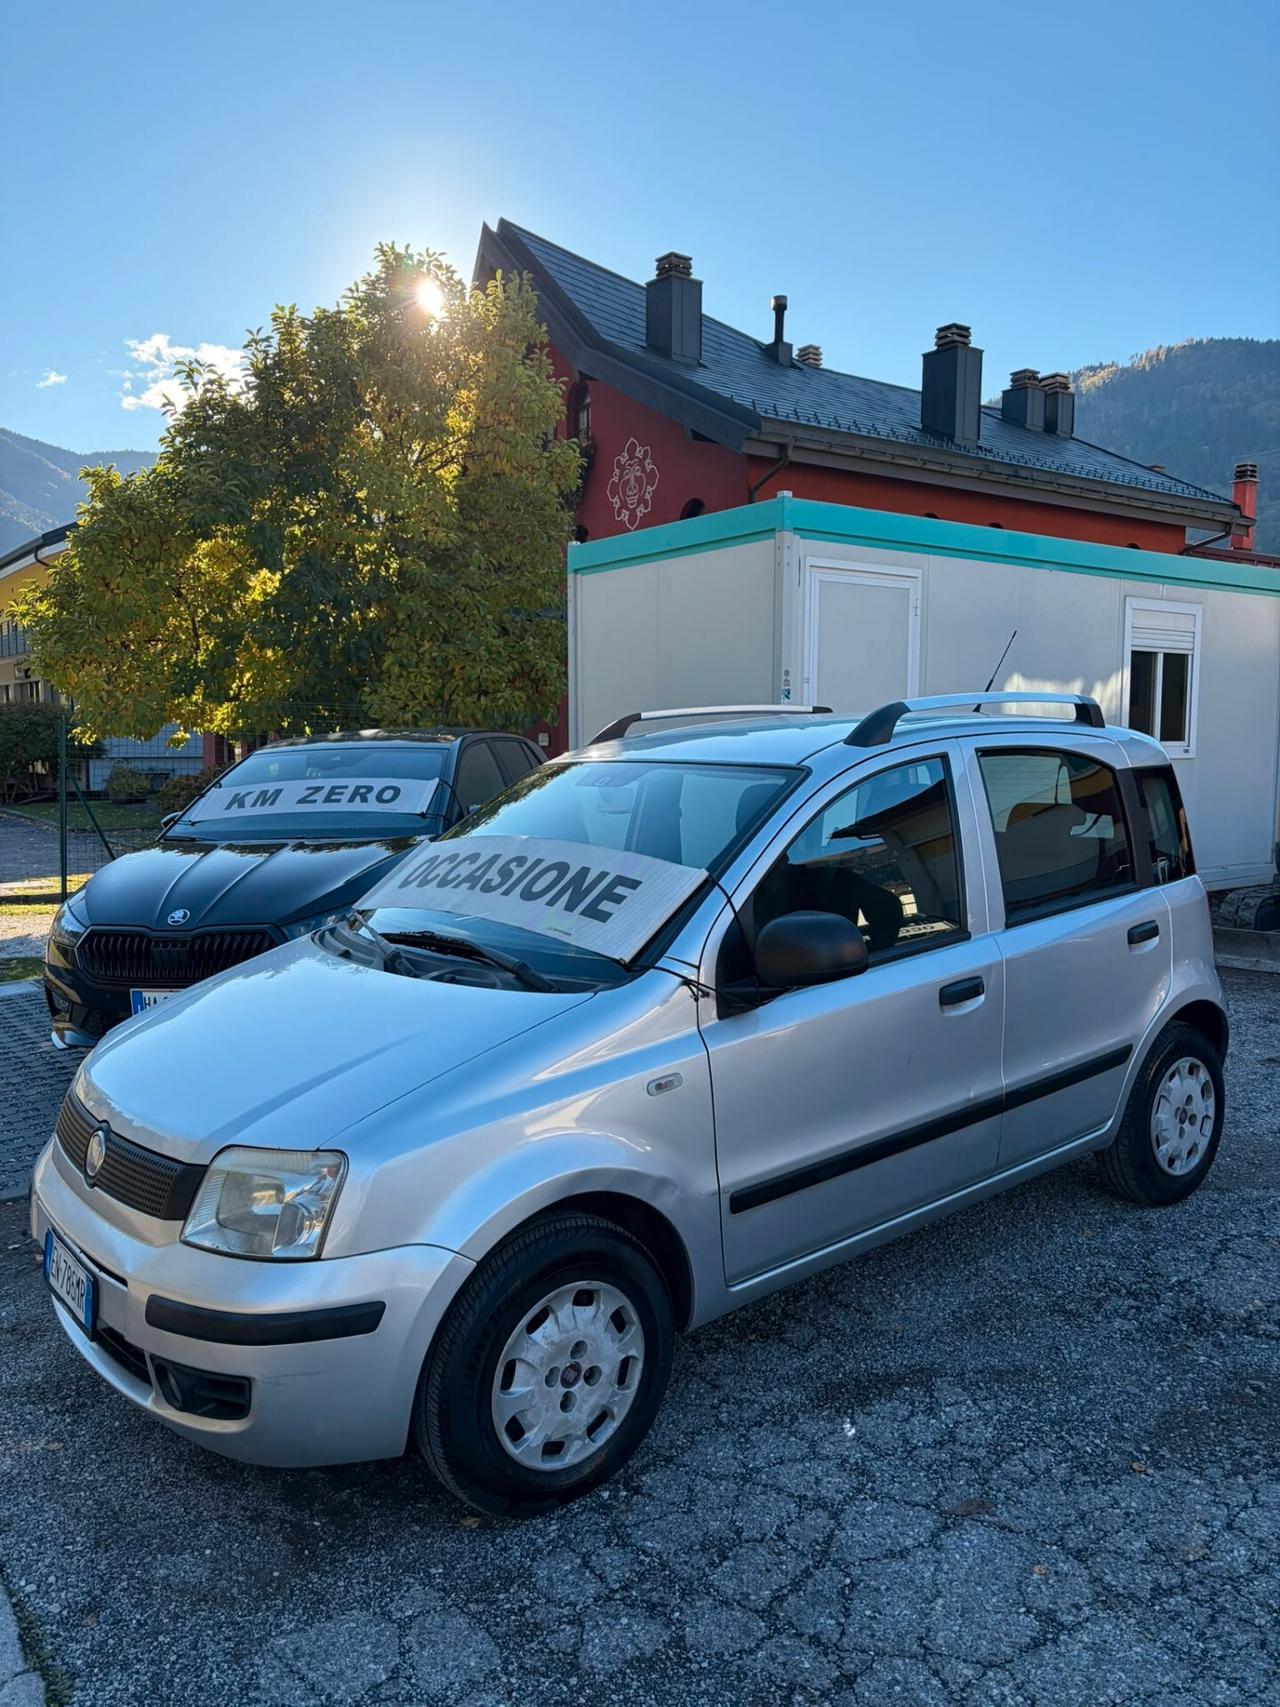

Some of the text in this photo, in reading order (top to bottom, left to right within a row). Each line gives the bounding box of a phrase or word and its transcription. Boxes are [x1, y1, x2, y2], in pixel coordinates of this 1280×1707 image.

[224, 785, 401, 811] KM ZERO
[398, 852, 643, 923] OCCASIONE
